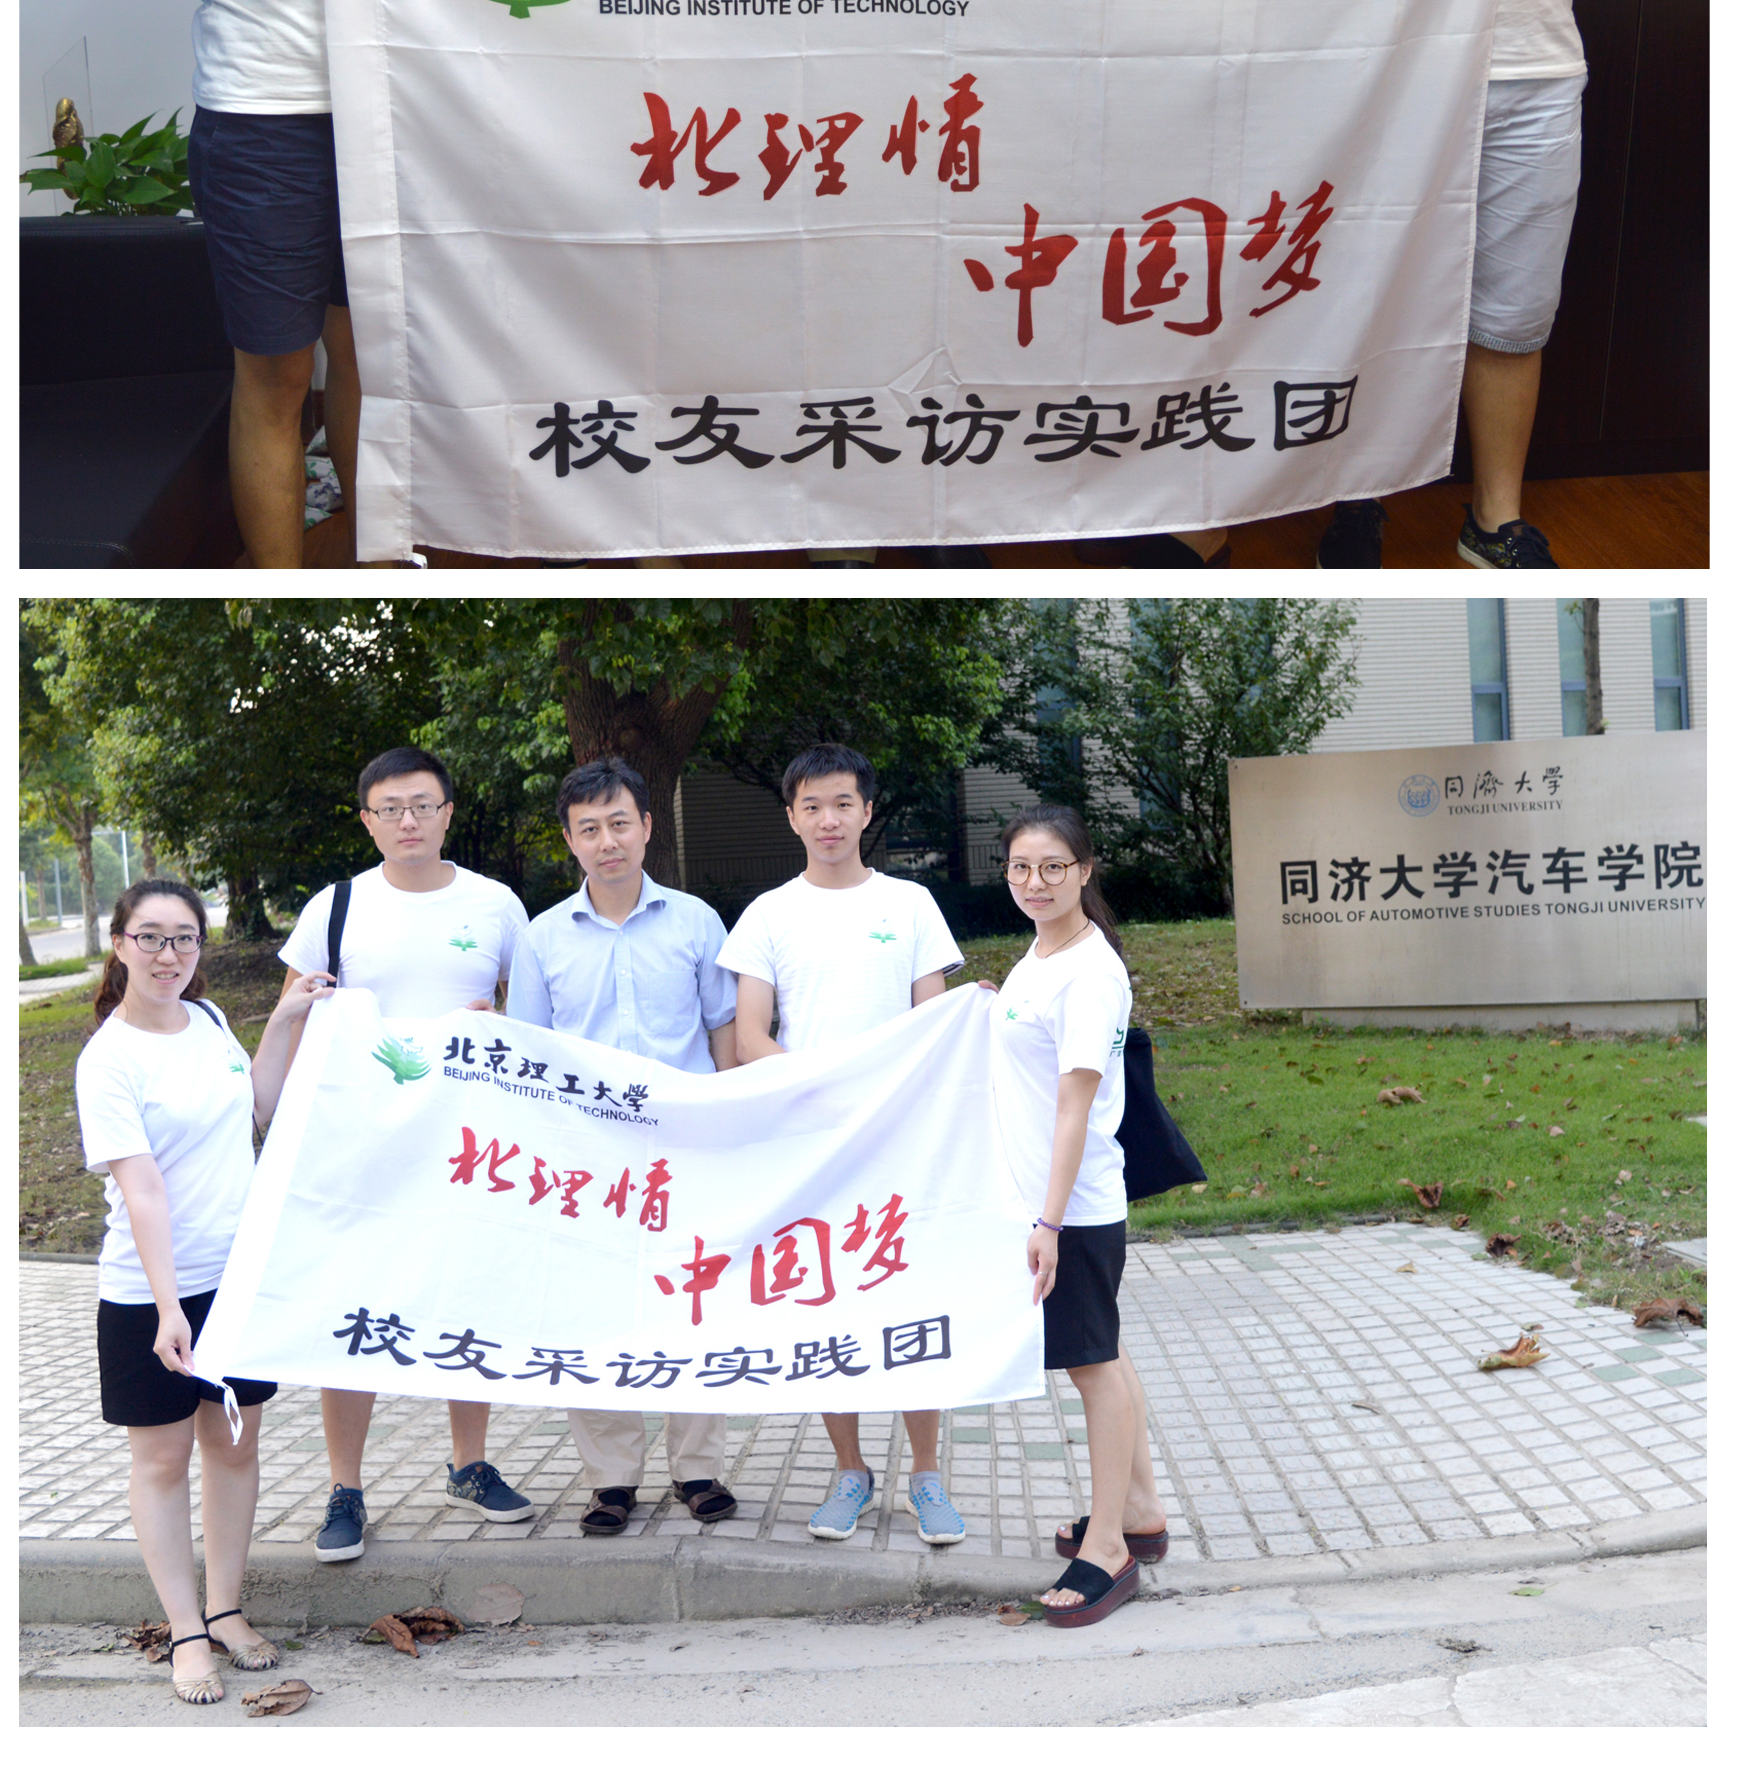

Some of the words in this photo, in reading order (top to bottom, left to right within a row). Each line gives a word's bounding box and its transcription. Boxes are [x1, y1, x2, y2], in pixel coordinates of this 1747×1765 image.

[631, 73, 984, 199] 北理情
[964, 181, 1334, 346] 中国梦
[529, 375, 1358, 477] 校友采访实践团
[1447, 804, 1490, 816] TONGJI
[1492, 799, 1563, 813] UNIVERSITY
[1280, 841, 1704, 905] 同济大学汽车学院
[1282, 911, 1343, 925] SCHOOL
[1347, 910, 1366, 923] OF
[1369, 906, 1469, 922] AUTOMOTIVE
[1473, 904, 1541, 917] STUDIES
[1545, 901, 1603, 915] TONGJI
[1608, 897, 1706, 913] UNIVERSITY
[443, 1066, 490, 1082] BEIJING
[494, 1076, 555, 1101] INSTITUTE
[559, 1095, 574, 1106] OF
[576, 1103, 659, 1127] TECHNOLOGY
[449, 1127, 672, 1231] 北理情
[655, 1194, 908, 1325] 中国梦
[333, 1308, 951, 1388] 校友采访实践团
